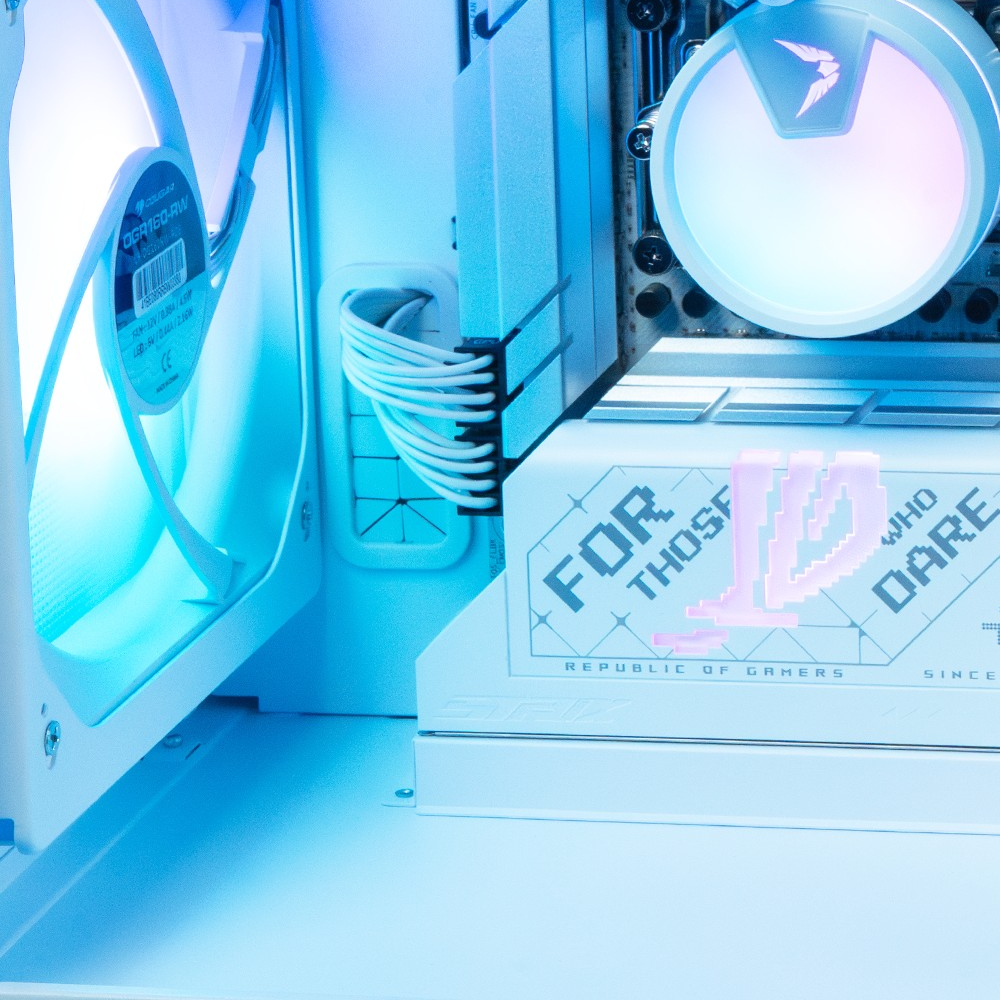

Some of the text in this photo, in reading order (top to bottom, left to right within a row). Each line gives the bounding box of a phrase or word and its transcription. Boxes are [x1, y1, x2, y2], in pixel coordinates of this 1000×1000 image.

[881, 488, 938, 546] WHO
[543, 485, 674, 613] FOR
[564, 661, 845, 679] REPUBLIC OF GAMERS
[923, 668, 997, 681] SINCE
